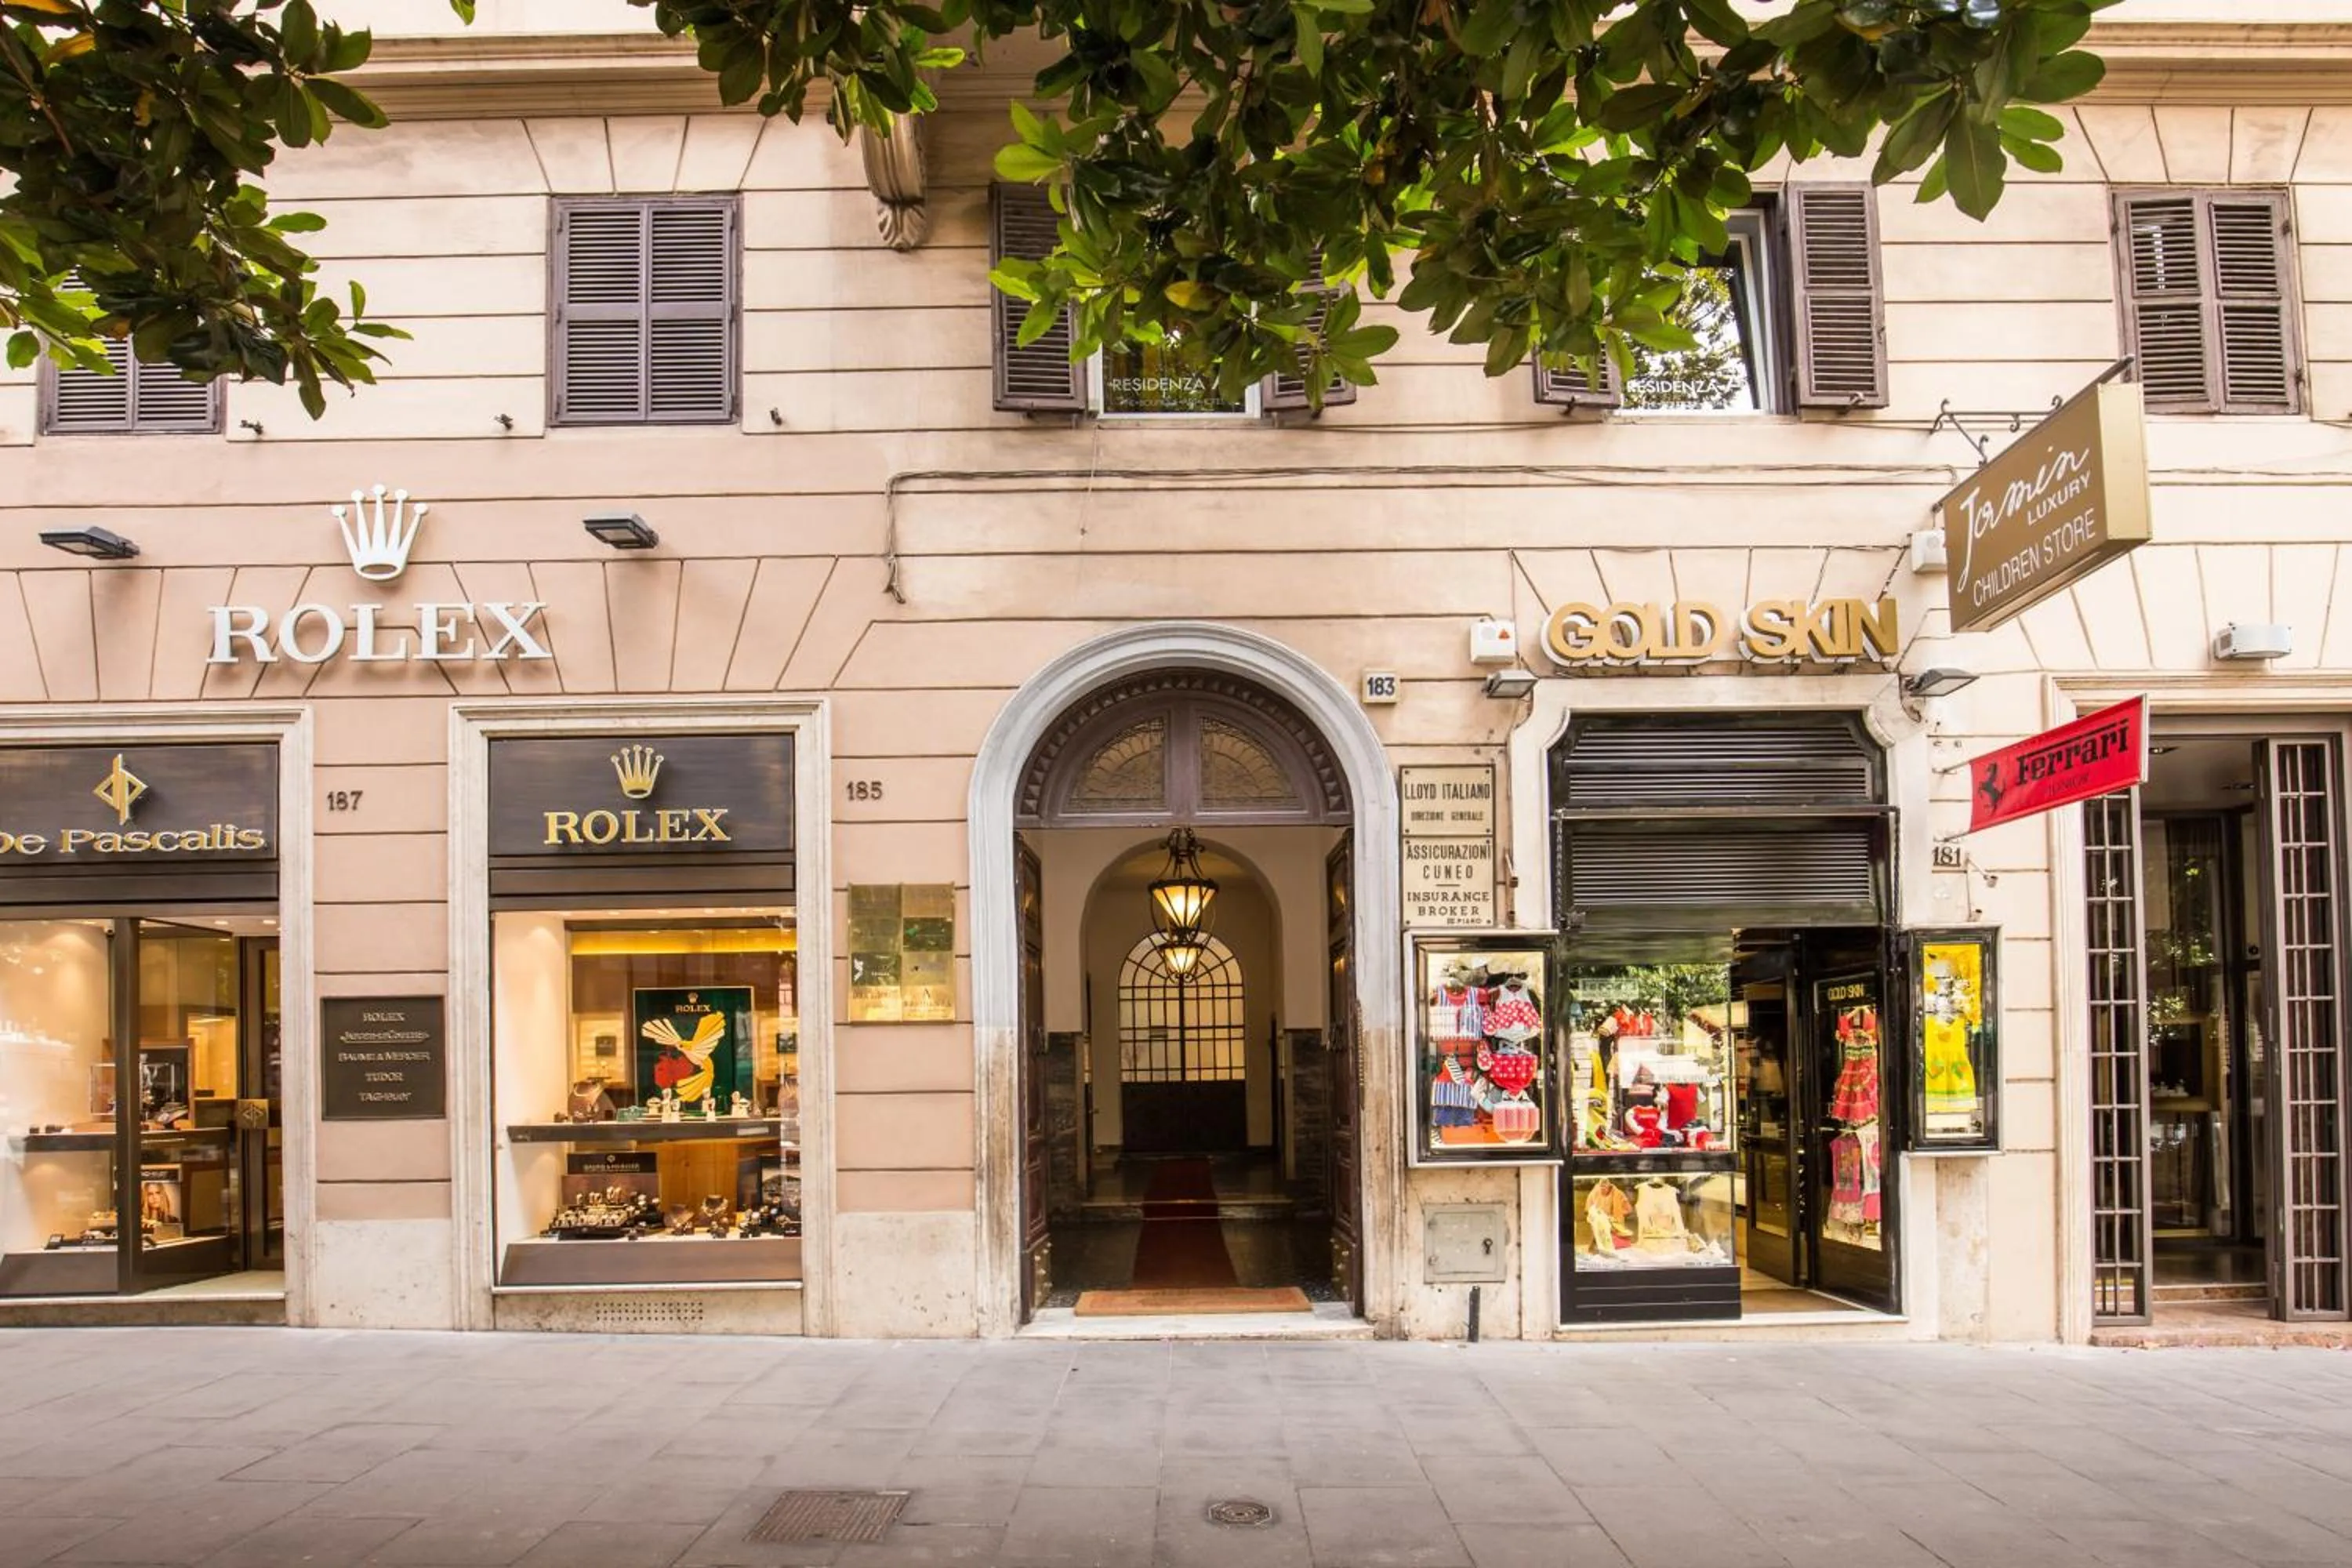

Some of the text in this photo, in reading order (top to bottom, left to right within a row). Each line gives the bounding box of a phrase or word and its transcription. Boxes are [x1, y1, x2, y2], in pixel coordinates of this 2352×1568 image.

[1111, 376, 1206, 391] RESIDENZA
[1627, 379, 1719, 393] RESIDENZA
[2027, 470, 2092, 526] LUXURY
[1973, 507, 2096, 607] CHILDREN STORE
[205, 601, 553, 664] ROLEX
[1543, 597, 1898, 663] GOLD SKIN
[1367, 677, 1395, 696] 183
[2016, 717, 2130, 786] Ferrari
[847, 781, 883, 800] 185
[1404, 782, 1490, 800] LLOYD ITALIANO
[327, 790, 363, 811] 187
[543, 808, 731, 845] ROLEX
[59, 823, 267, 854] Pascalis
[1406, 844, 1492, 861] ASSICURAZIONI
[1932, 846, 1961, 867] 181
[1423, 864, 1474, 880] CUNEO
[1406, 891, 1490, 902] INSURANCE
[1417, 906, 1480, 916] BROKER
[363, 1012, 405, 1021] ROLEX
[675, 1004, 712, 1013] ROLEX
[365, 1072, 405, 1082] TUDOR
